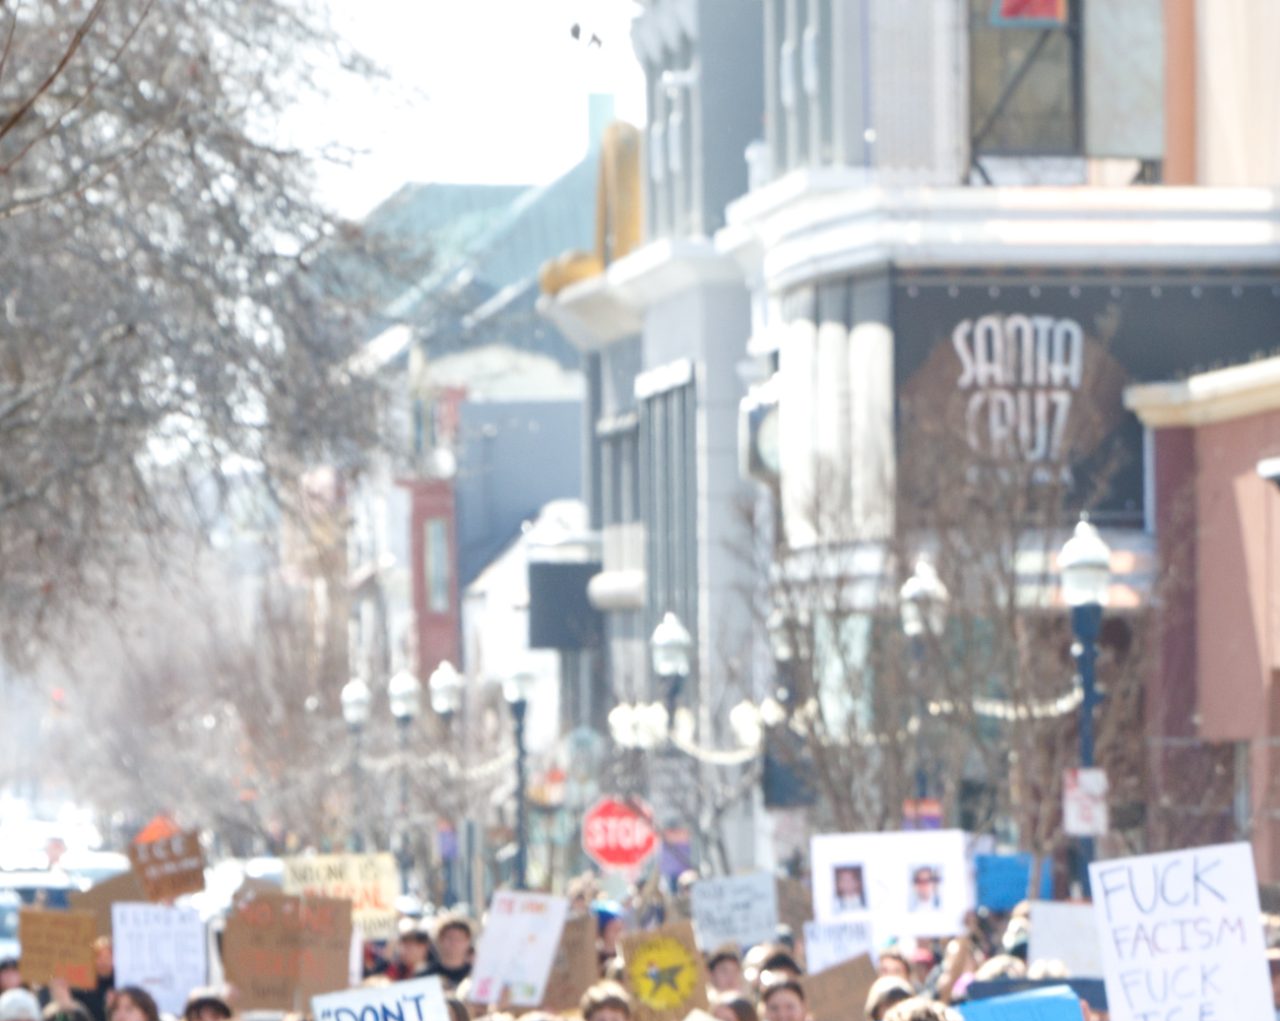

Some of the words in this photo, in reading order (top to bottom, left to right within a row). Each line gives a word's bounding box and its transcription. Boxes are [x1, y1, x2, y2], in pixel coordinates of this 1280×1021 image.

[953, 314, 1083, 389] SANTA
[965, 390, 1071, 462] CRUZ
[588, 815, 653, 850] STOP
[1099, 855, 1227, 922] FUCK
[1112, 916, 1248, 959] FACISM
[1120, 962, 1224, 1009] FUCK
